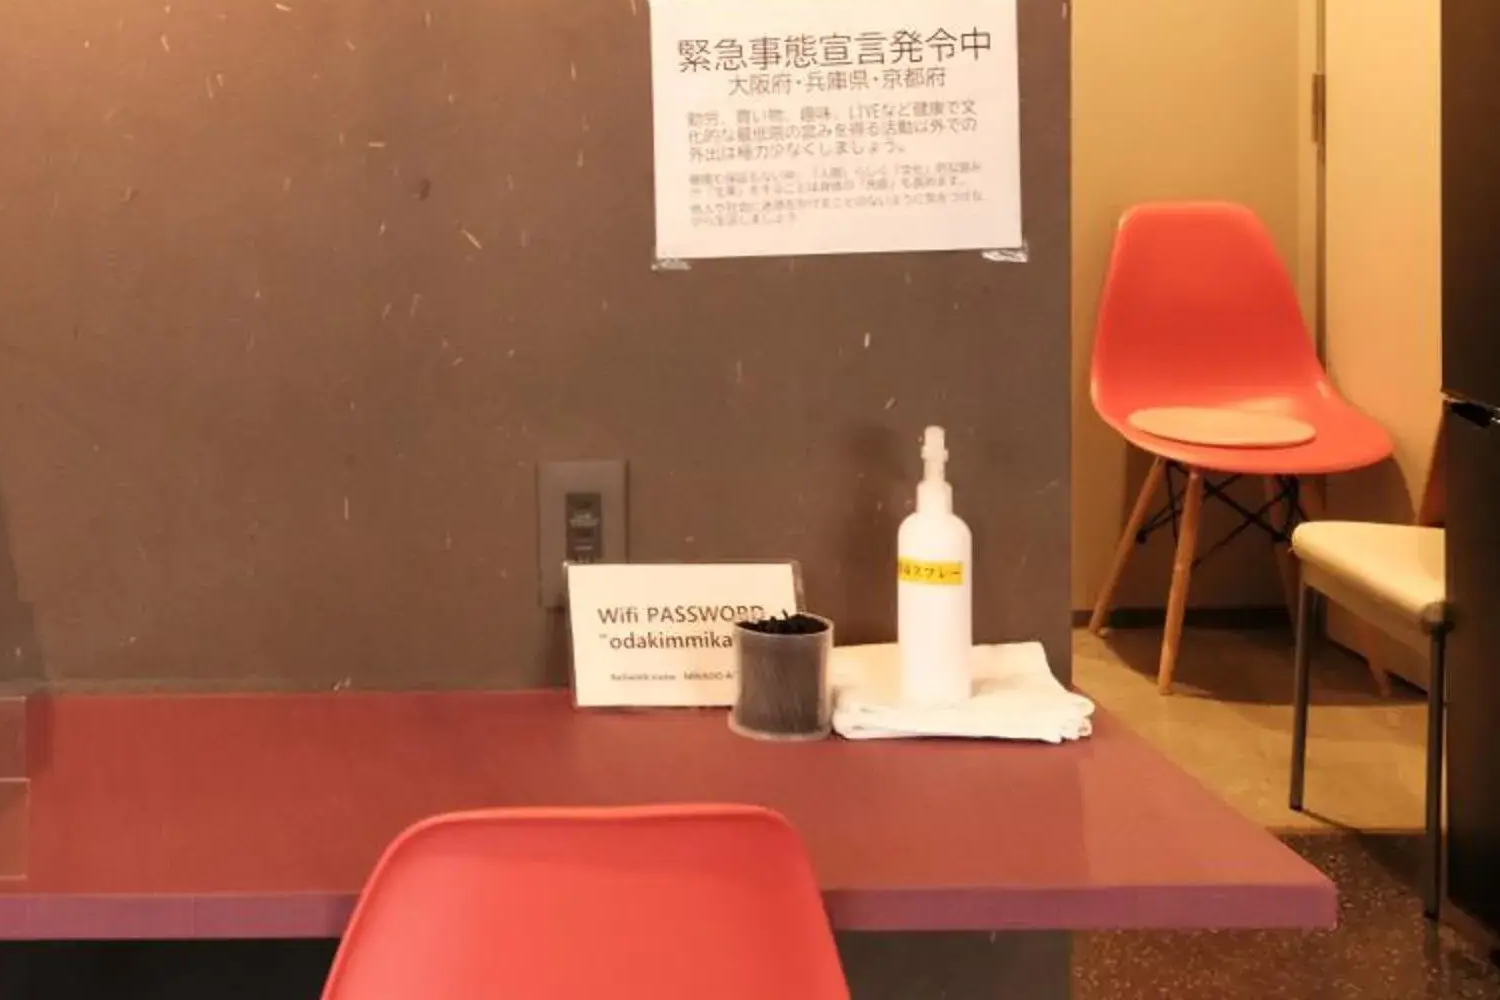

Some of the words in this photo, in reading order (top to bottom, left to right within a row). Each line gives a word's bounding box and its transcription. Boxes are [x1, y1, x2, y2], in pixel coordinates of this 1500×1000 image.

[678, 26, 992, 73] 緊急事態宣言発令中
[597, 607, 639, 624] Wifi
[647, 605, 765, 623] PASSWORD
[599, 631, 733, 649] "odakimmika
